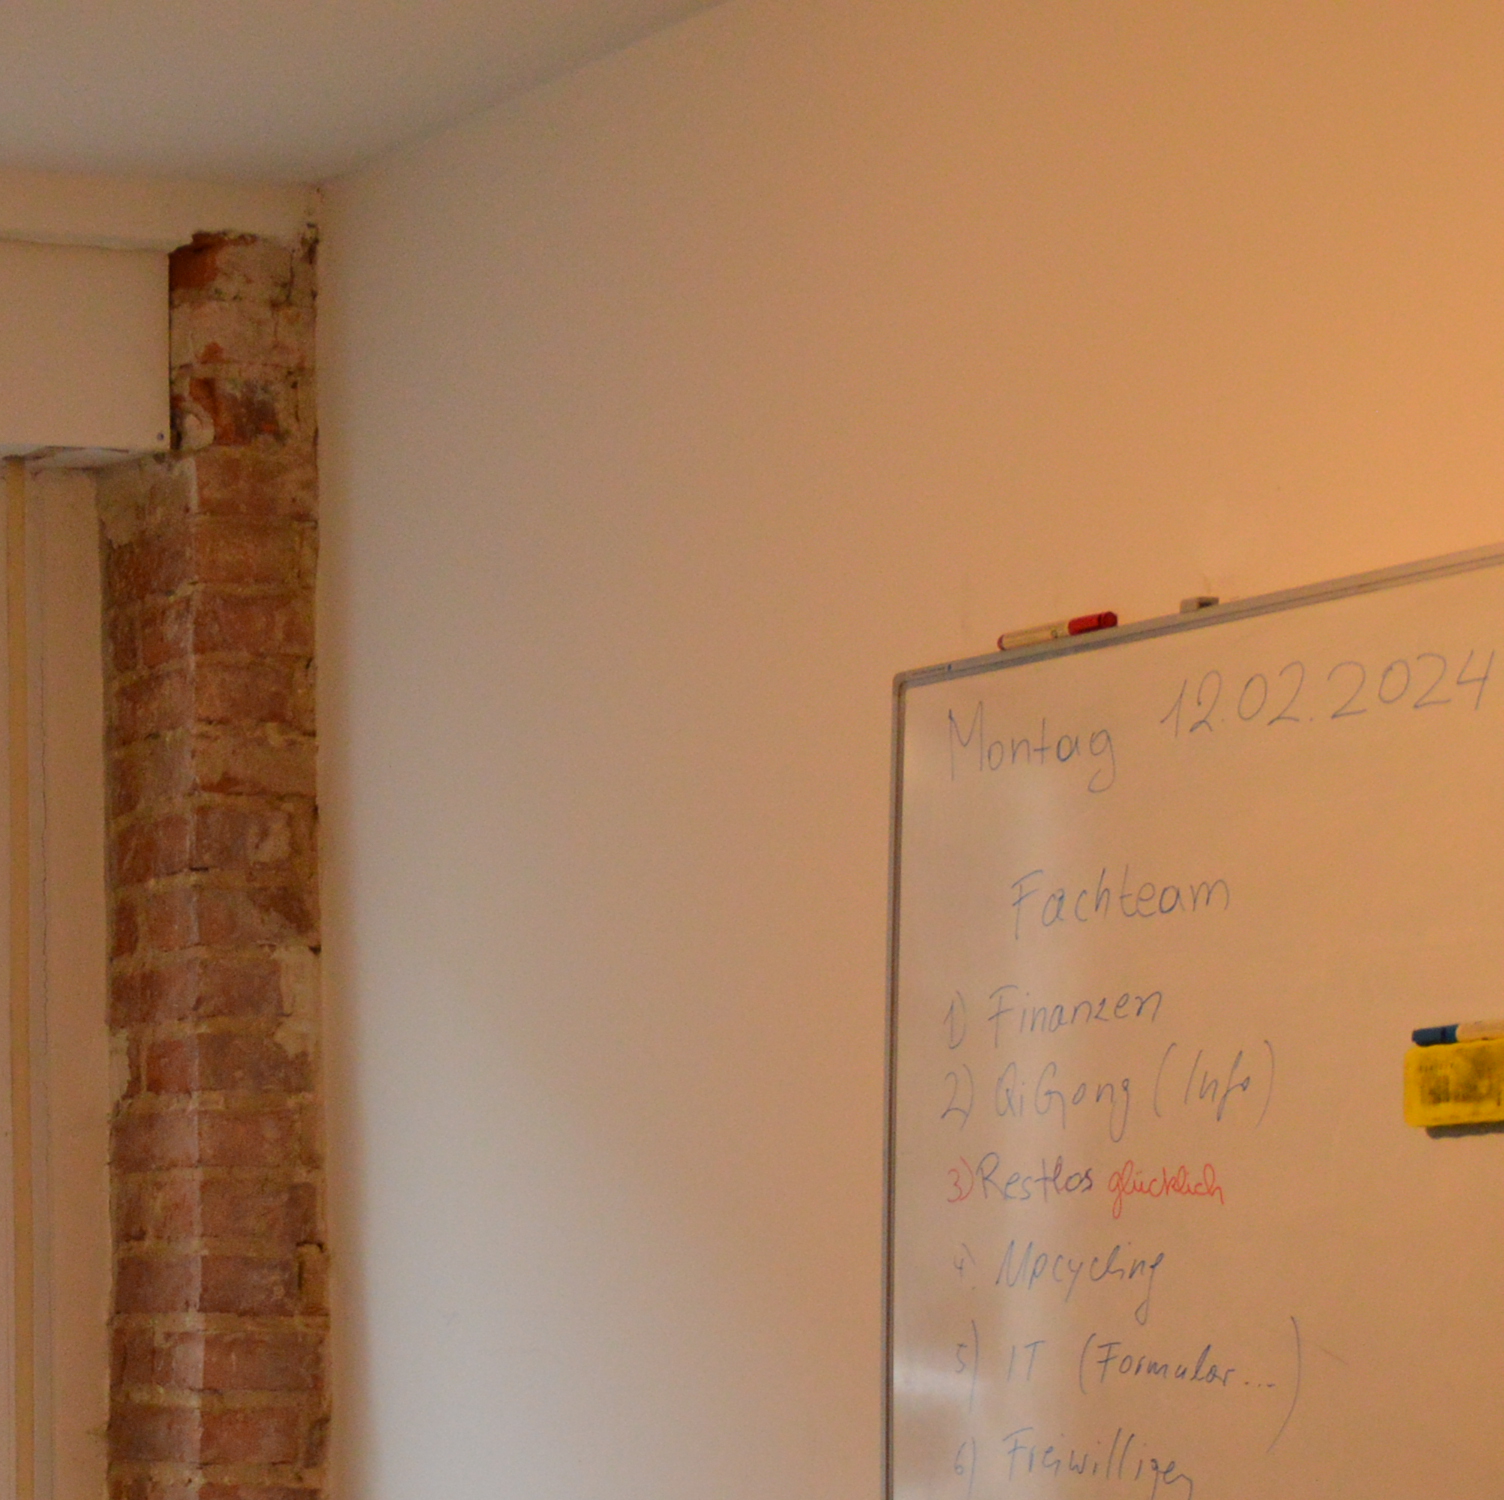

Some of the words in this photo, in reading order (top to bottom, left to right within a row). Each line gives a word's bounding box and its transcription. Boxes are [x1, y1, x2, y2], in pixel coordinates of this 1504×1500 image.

[947, 700, 1117, 793] Montag
[1160, 649, 1495, 738] 12.02.2024
[1011, 864, 1231, 940] Fachteam
[988, 984, 1163, 1048] Finanzen
[941, 1062, 974, 1129] 2)
[1153, 1040, 1275, 1129] (Info)
[976, 1151, 1093, 1202] Restlos
[1108, 1160, 1225, 1219] glücklich
